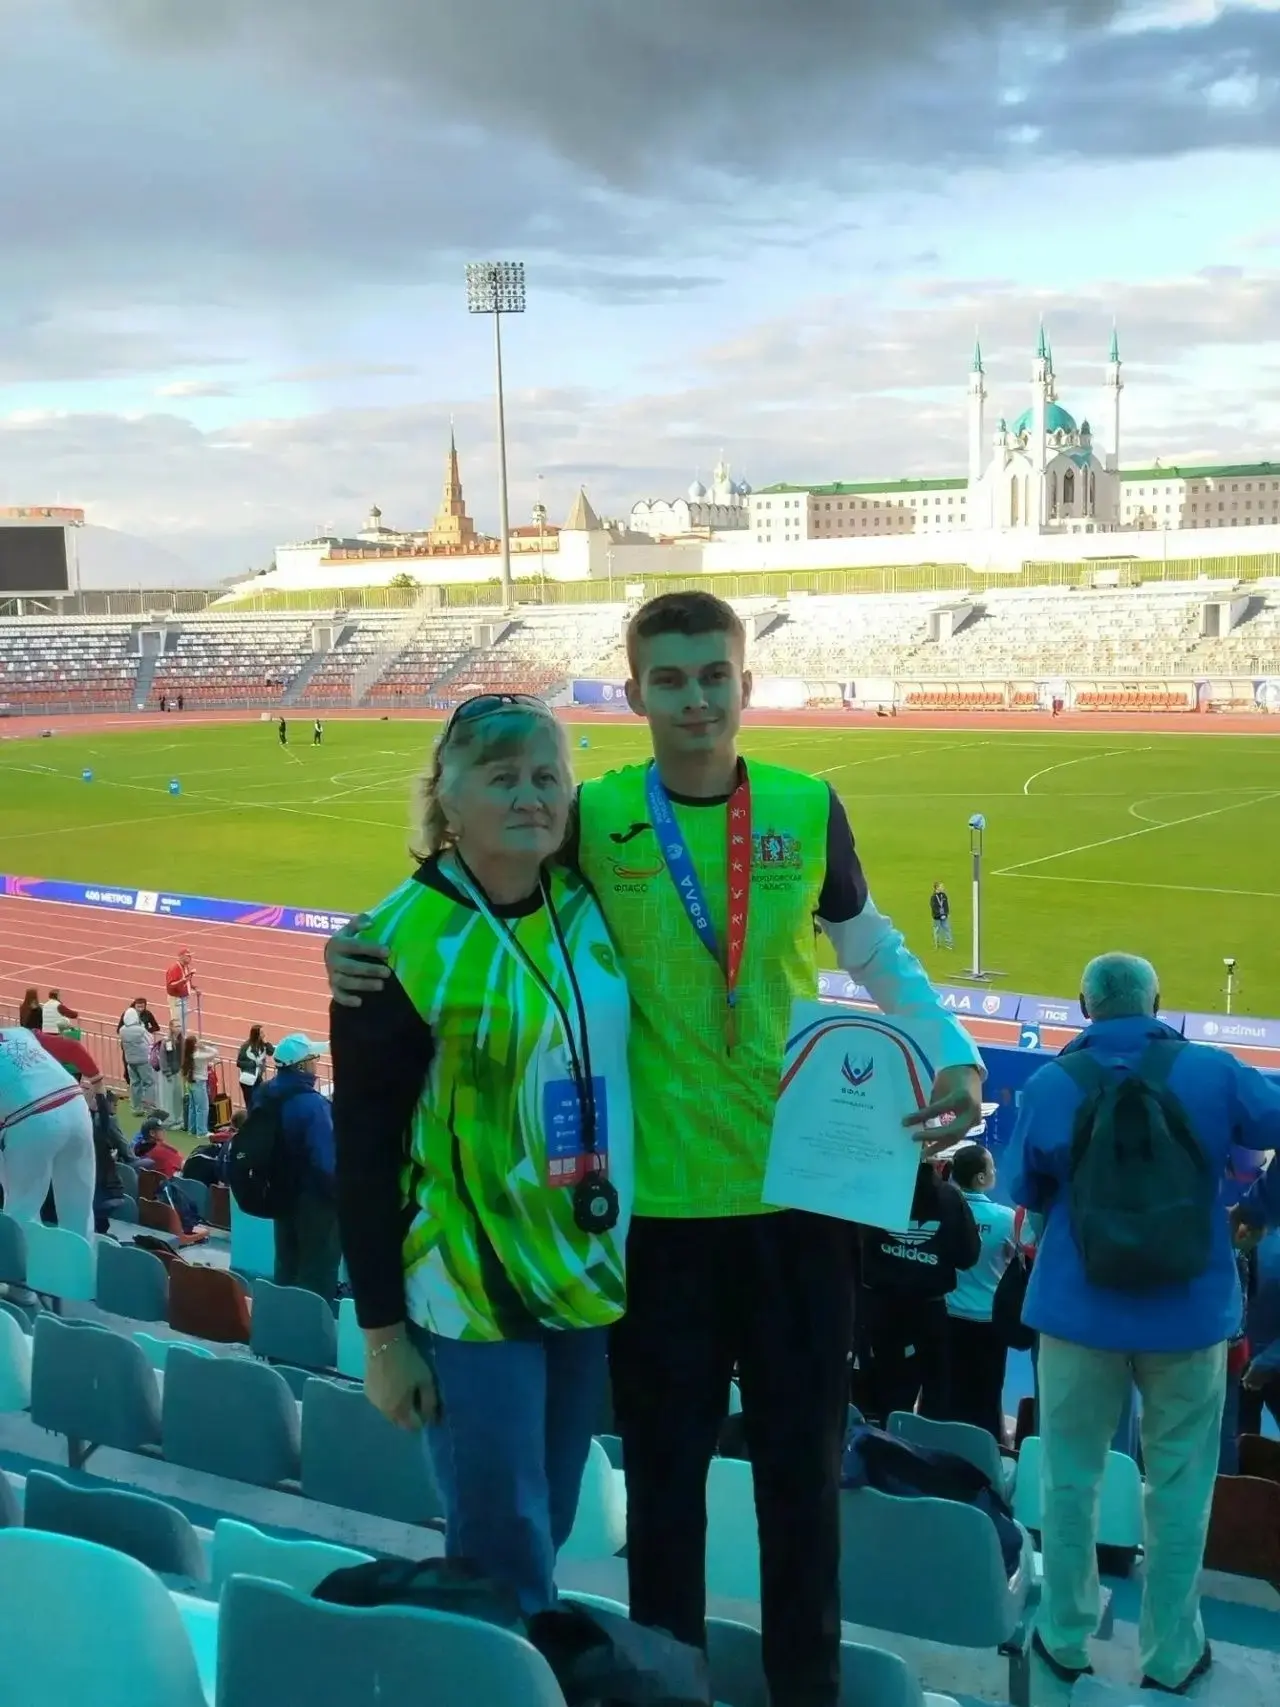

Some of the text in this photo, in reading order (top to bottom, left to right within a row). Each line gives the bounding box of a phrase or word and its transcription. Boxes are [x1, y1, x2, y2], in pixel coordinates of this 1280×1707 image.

[305, 913, 330, 929] ПСБ
[1221, 1023, 1266, 1037] azimut
[1021, 1031, 1038, 1049] 2
[880, 1242, 938, 1266] adidas
